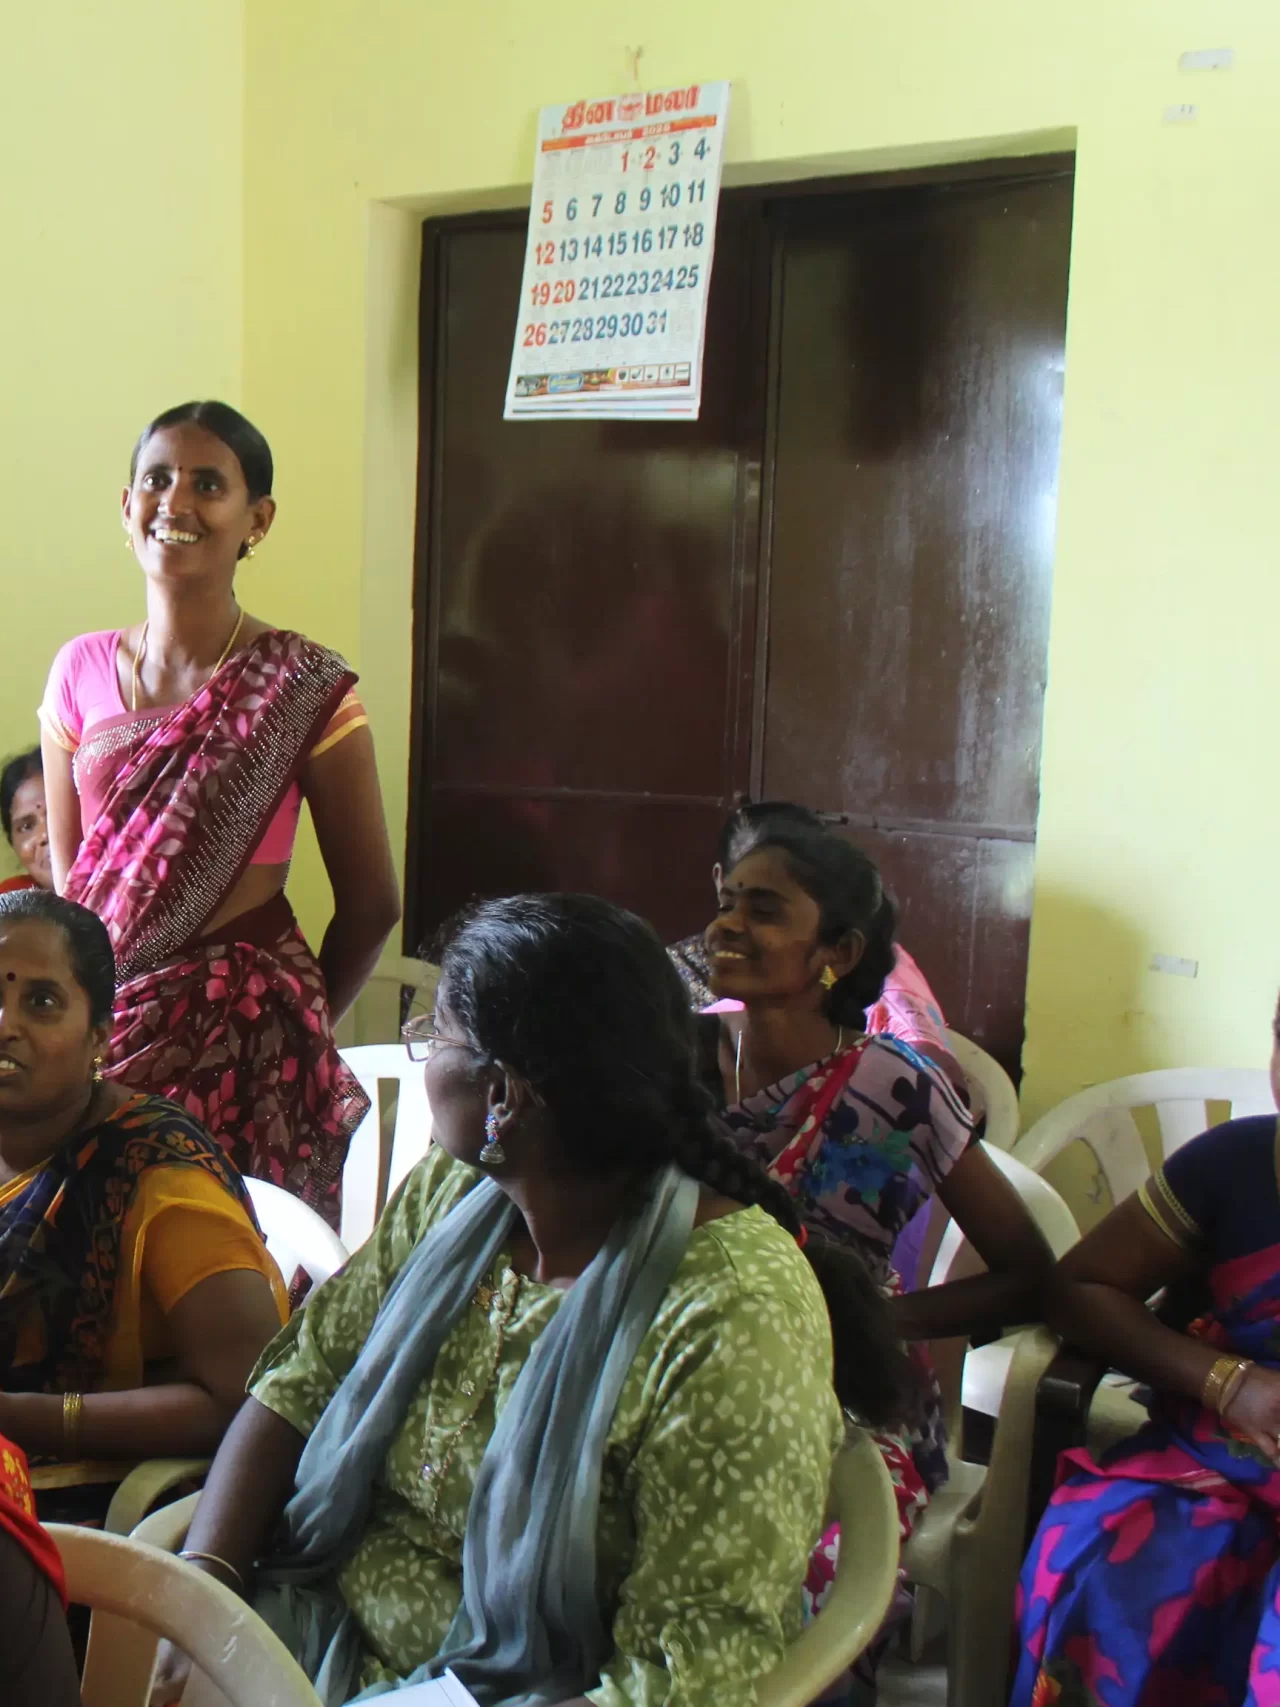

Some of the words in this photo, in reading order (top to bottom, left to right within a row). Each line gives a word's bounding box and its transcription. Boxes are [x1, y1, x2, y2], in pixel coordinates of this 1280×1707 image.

[622, 151, 629, 173] 1
[643, 146, 656, 170] 2
[669, 141, 680, 165] 3
[694, 137, 706, 160] 4
[542, 200, 553, 224] 5
[567, 197, 577, 221] 6
[592, 193, 602, 217] 7
[615, 191, 626, 214] 8
[640, 187, 651, 211] 9
[661, 183, 681, 208] 10
[688, 179, 705, 203] 11
[536, 241, 555, 265] 12
[560, 237, 578, 262] 13
[584, 234, 602, 258] 14
[608, 231, 627, 255] 15
[633, 228, 652, 252] 16
[659, 225, 677, 249] 17
[683, 222, 703, 247] 18
[531, 281, 550, 305] 19
[554, 279, 575, 304] 20
[578, 276, 598, 300] 21
[601, 273, 624, 298] 22
[625, 271, 649, 295] 23
[651, 268, 673, 292] 24
[675, 265, 698, 289] 25
[523, 323, 547, 347] 26
[548, 320, 570, 344] 27
[571, 317, 593, 342] 28
[595, 314, 618, 339] 29
[620, 312, 643, 337] 30
[647, 309, 667, 334] 31
